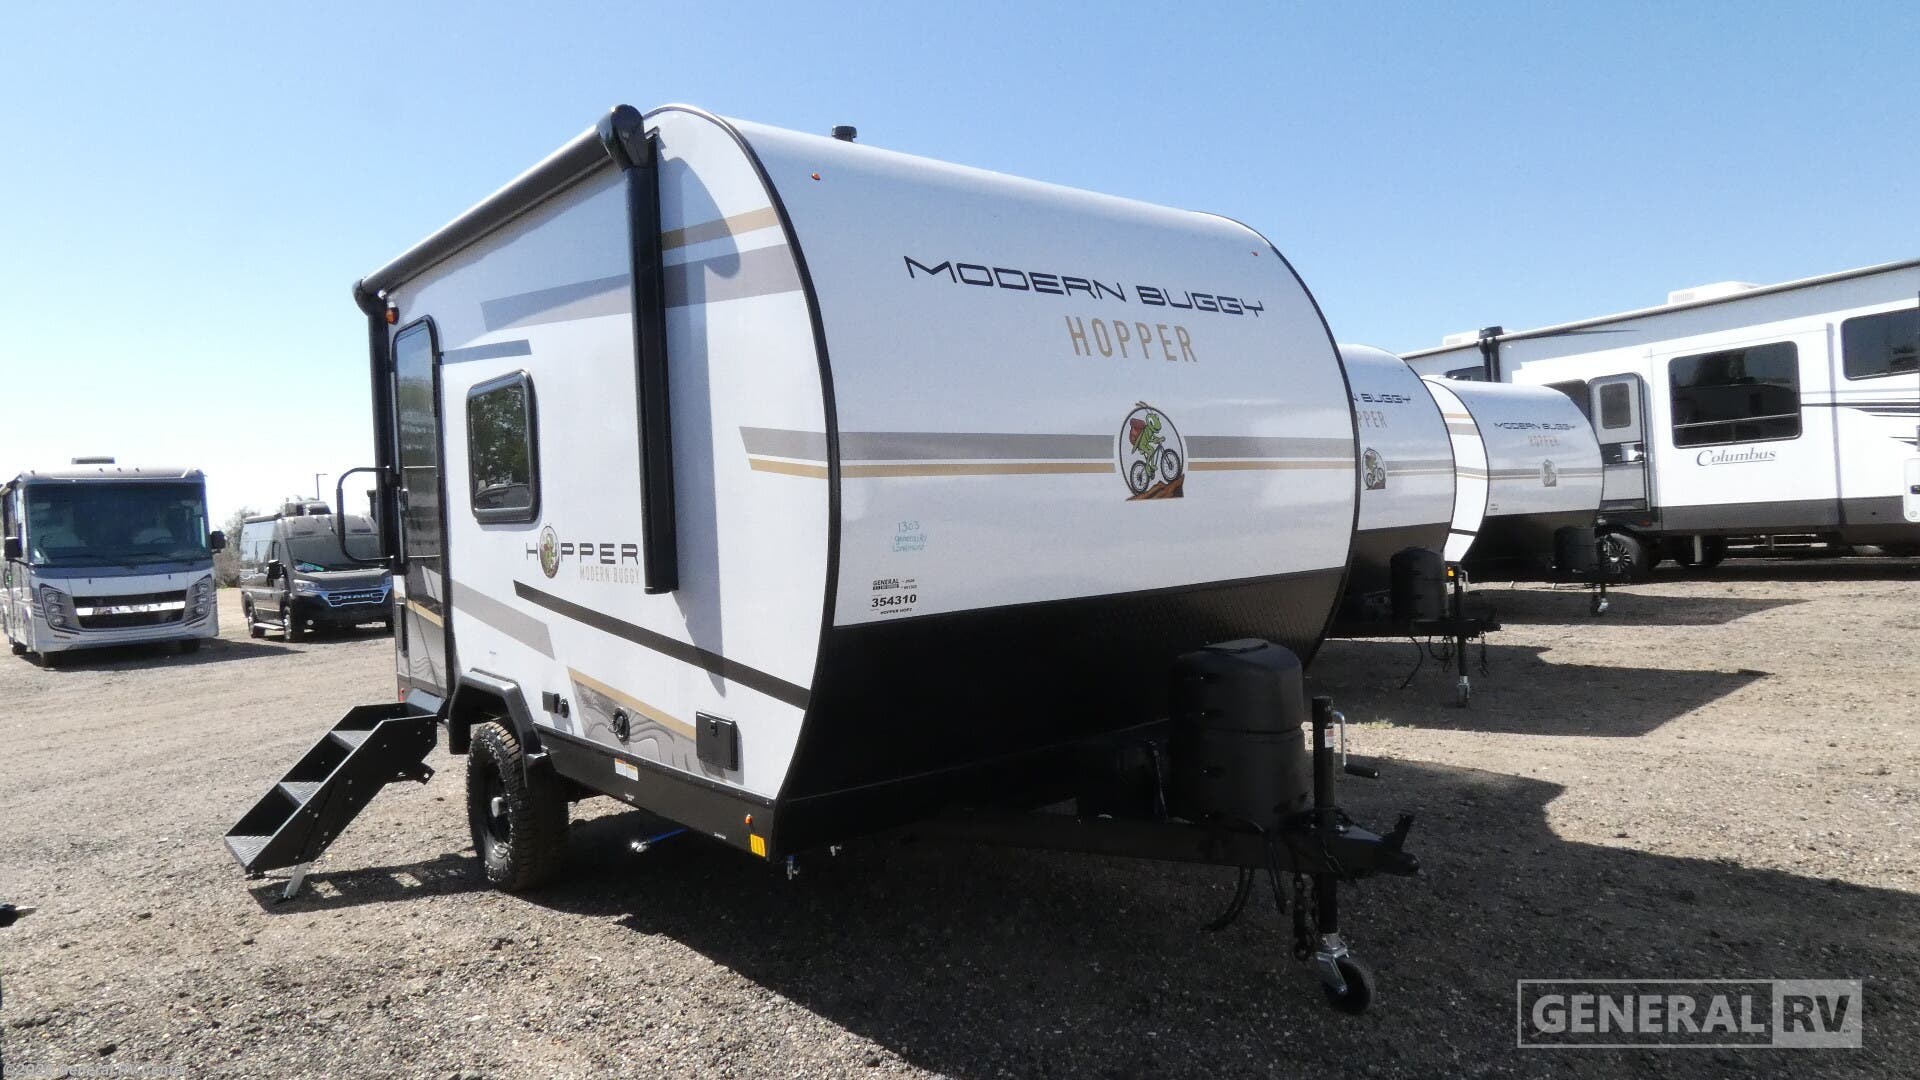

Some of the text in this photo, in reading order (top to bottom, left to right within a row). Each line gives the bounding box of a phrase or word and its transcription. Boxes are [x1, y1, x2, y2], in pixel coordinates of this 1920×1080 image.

[903, 255, 1265, 318] MODERN BUGGY
[1064, 314, 1198, 364] HOPPER
[1696, 447, 1777, 467] Columbus
[579, 566, 640, 584] MODERN BUGGY
[871, 594, 917, 608] 354310
